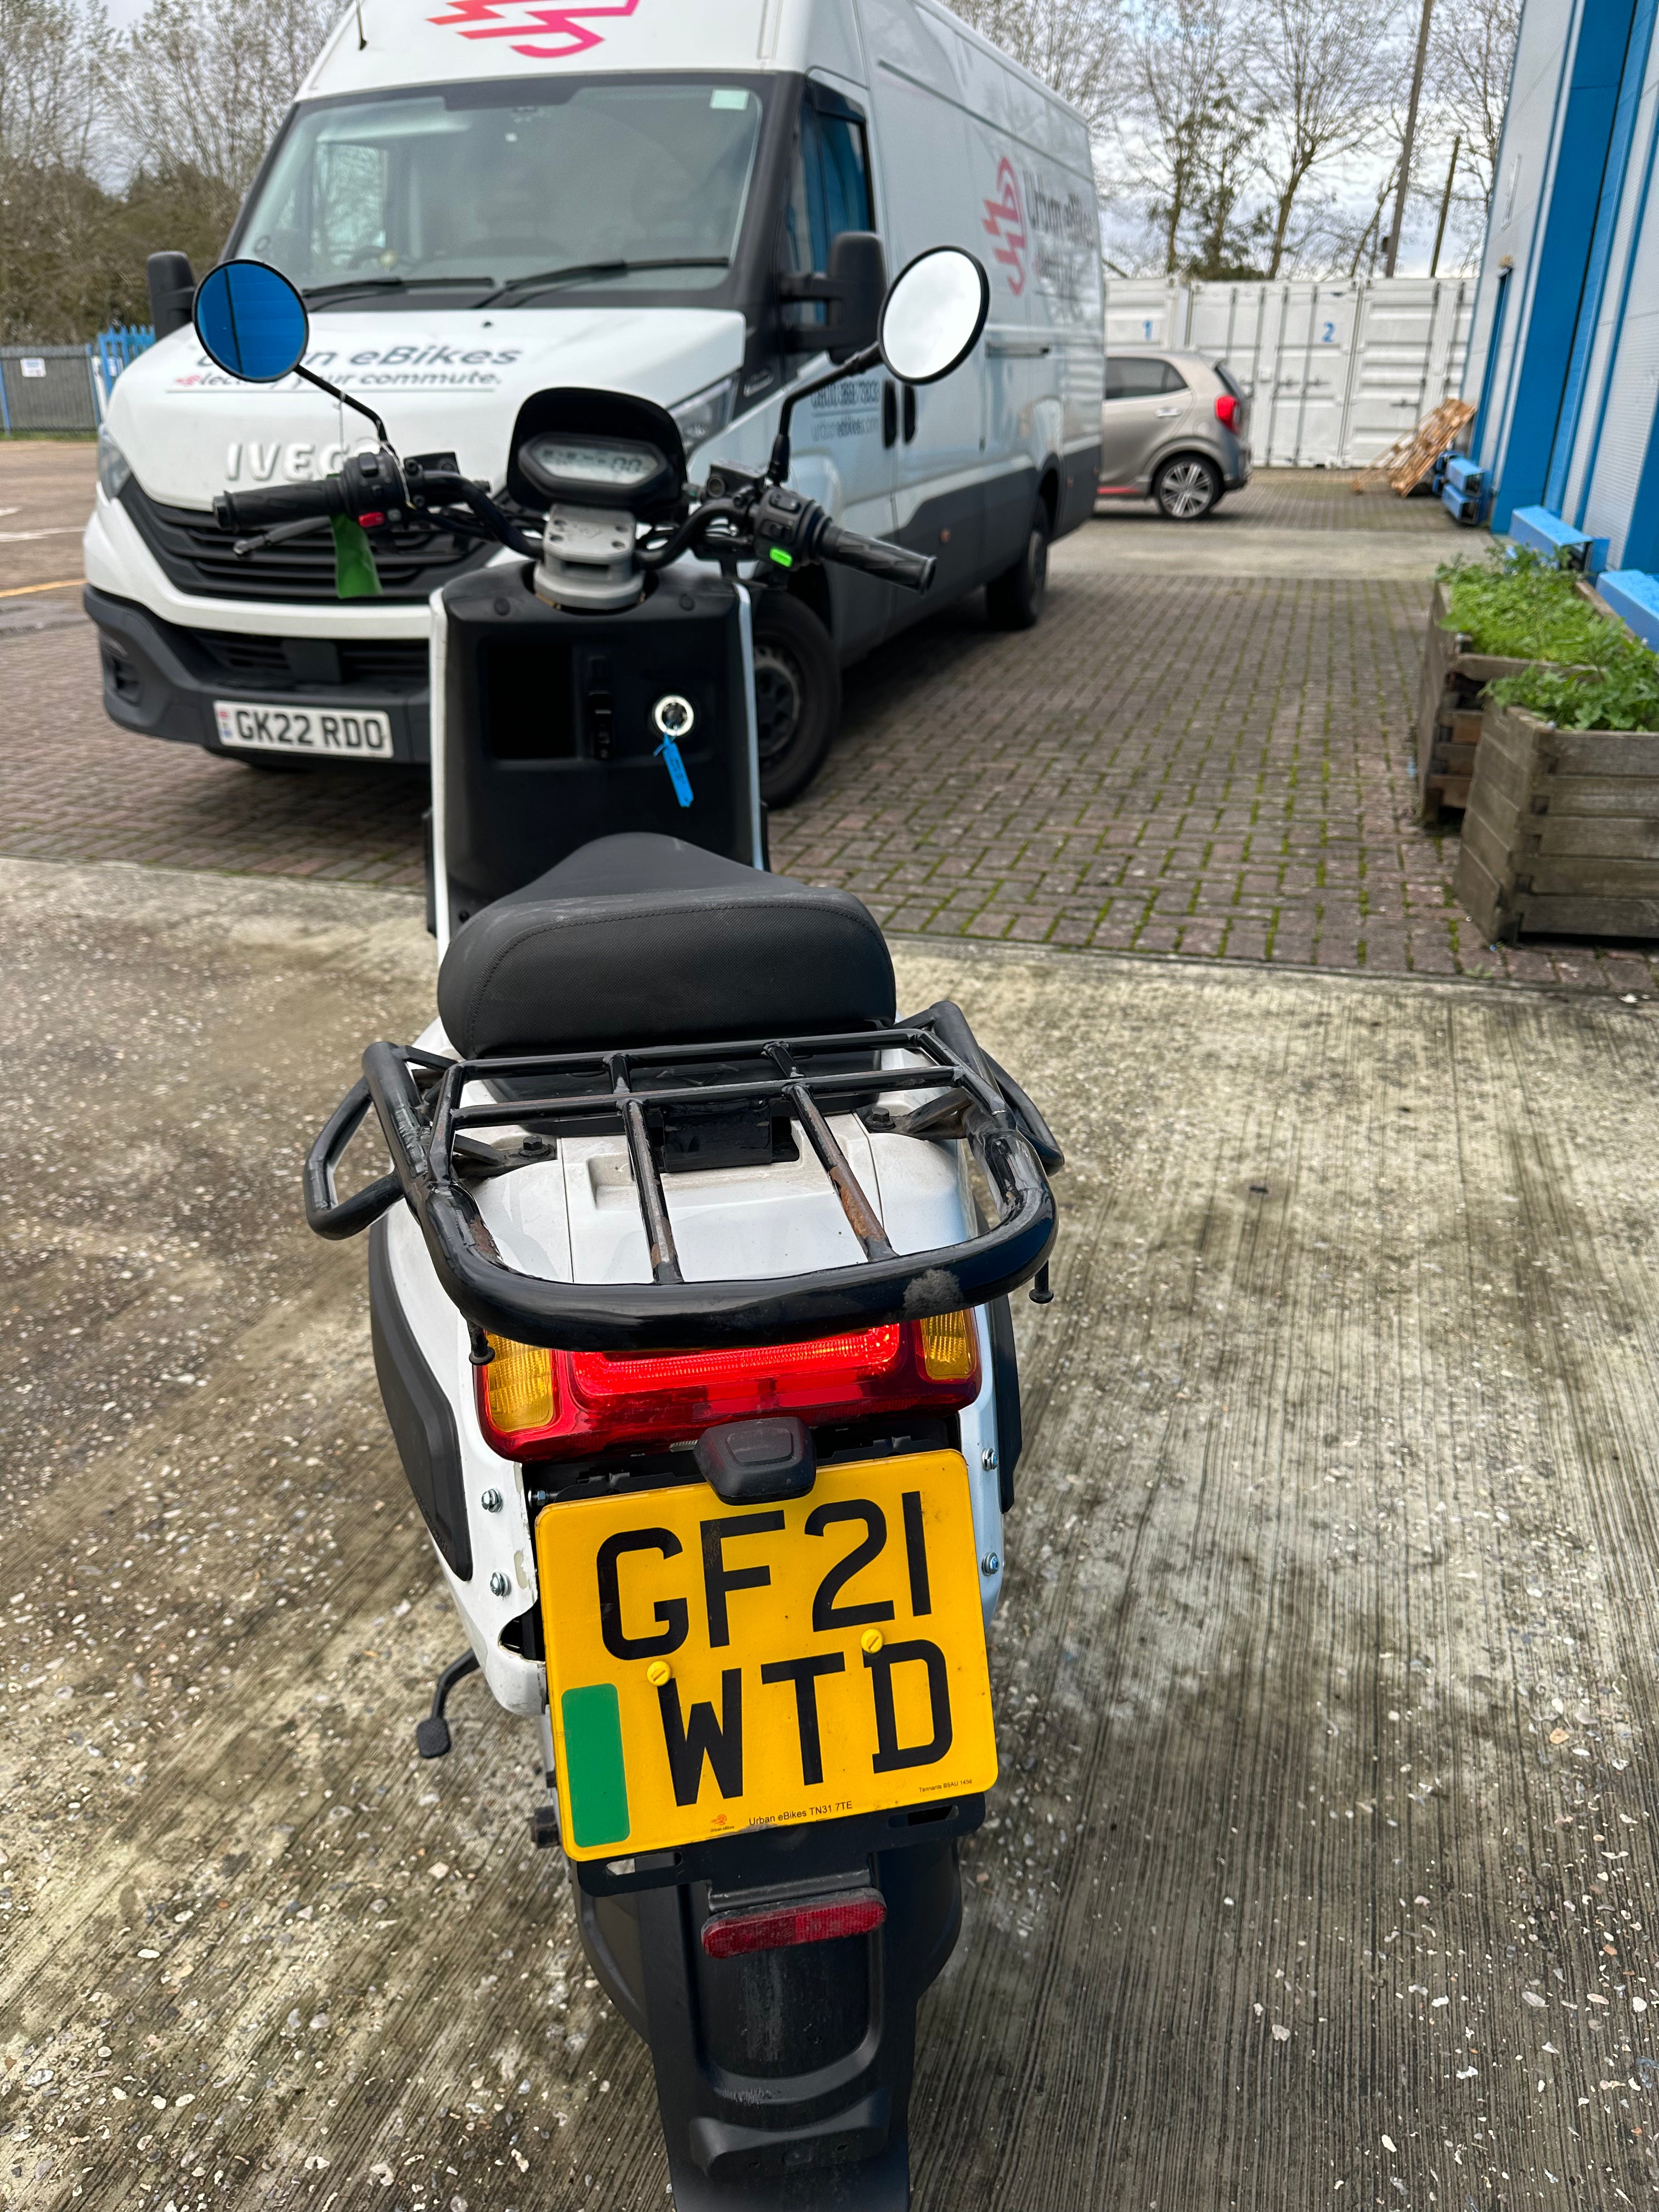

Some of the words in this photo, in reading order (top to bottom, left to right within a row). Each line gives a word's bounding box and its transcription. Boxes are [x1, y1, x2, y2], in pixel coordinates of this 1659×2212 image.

[1143, 320, 1152, 341] 1
[1322, 321, 1335, 342] 2
[349, 345, 522, 366] eBikes
[359, 371, 502, 385] commute.
[225, 439, 380, 482] IVEC
[235, 711, 313, 746] GK22
[321, 716, 384, 748] RDO
[596, 1491, 932, 1661] GF21
[657, 1639, 953, 1807] WTD
[749, 1815, 775, 1826] Urban
[777, 1810, 807, 1821] eBikes
[809, 1804, 832, 1816] TN31
[835, 1801, 853, 1812] 7TE
